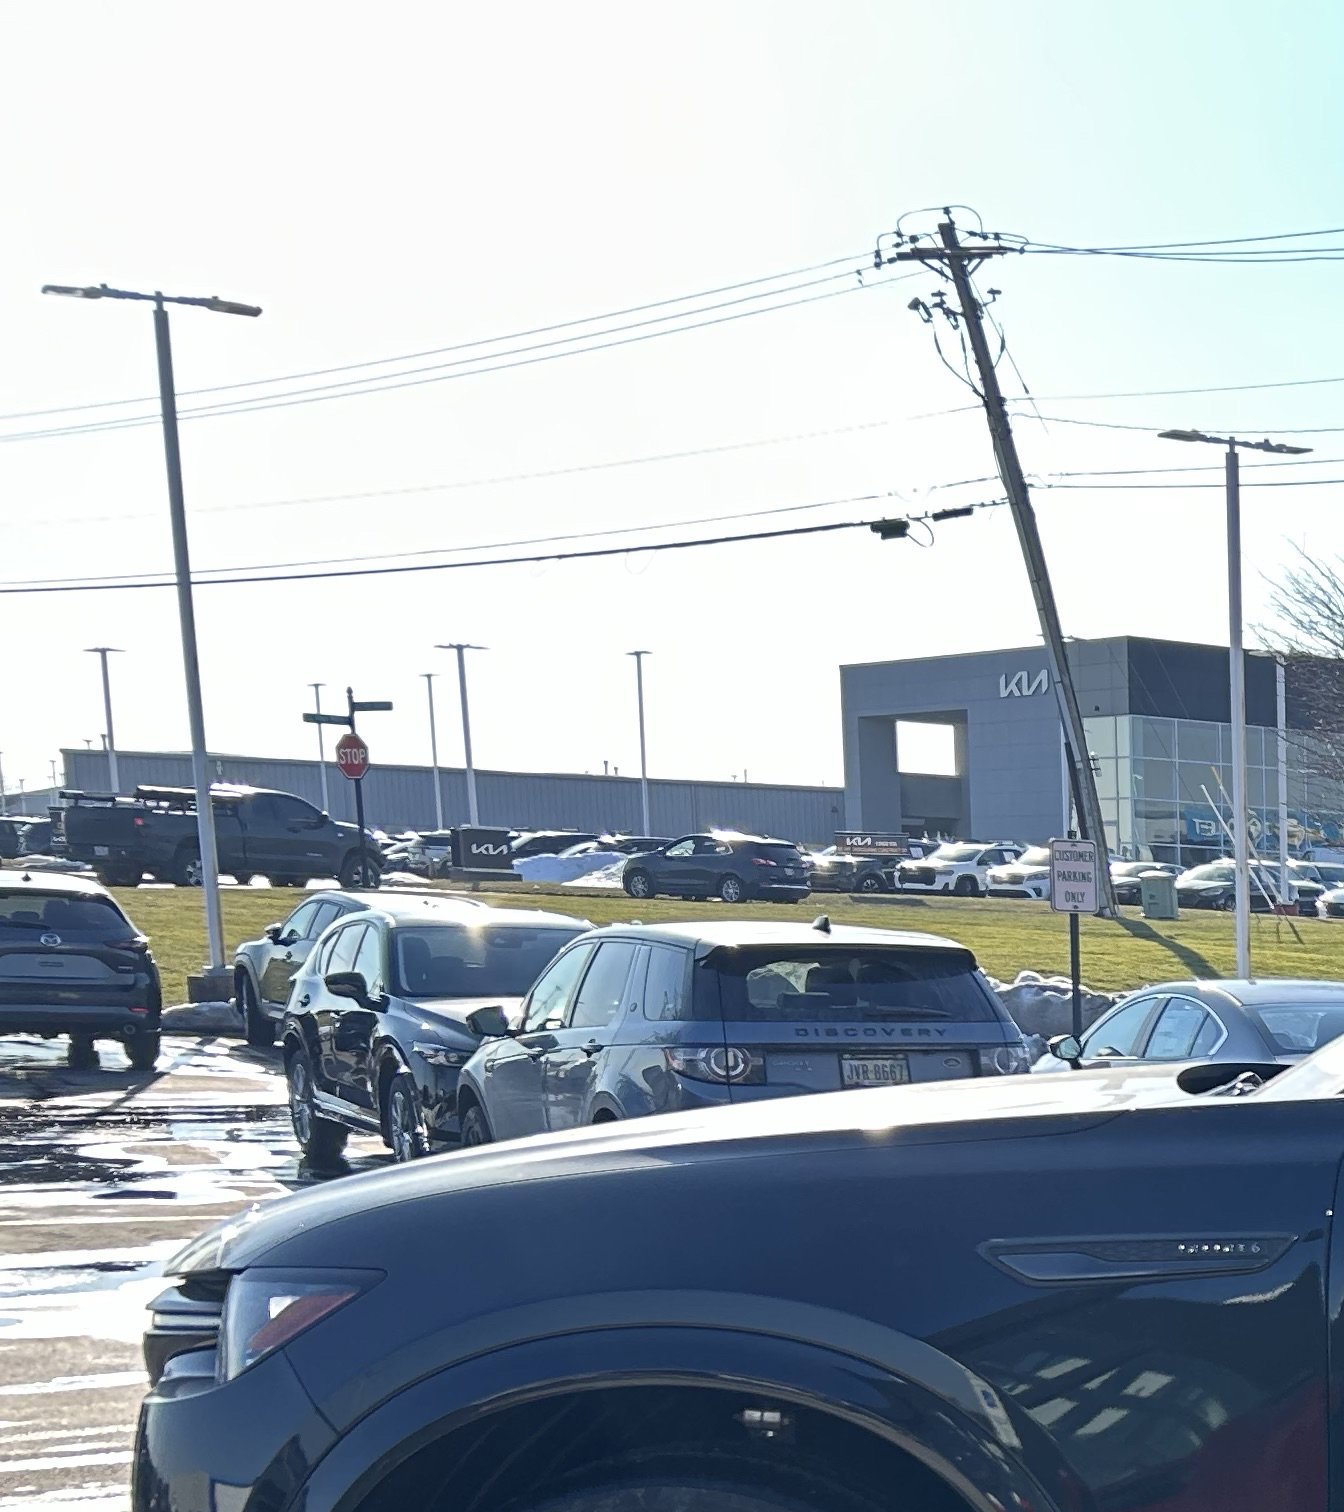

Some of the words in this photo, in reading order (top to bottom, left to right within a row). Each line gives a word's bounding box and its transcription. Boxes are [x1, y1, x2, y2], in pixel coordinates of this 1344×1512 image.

[339, 748, 366, 765] STOP
[1054, 850, 1096, 863] CUSTOMER
[1056, 870, 1093, 883] PARKING
[1064, 890, 1086, 904] ONLY
[794, 1027, 948, 1038] DISCOVERY
